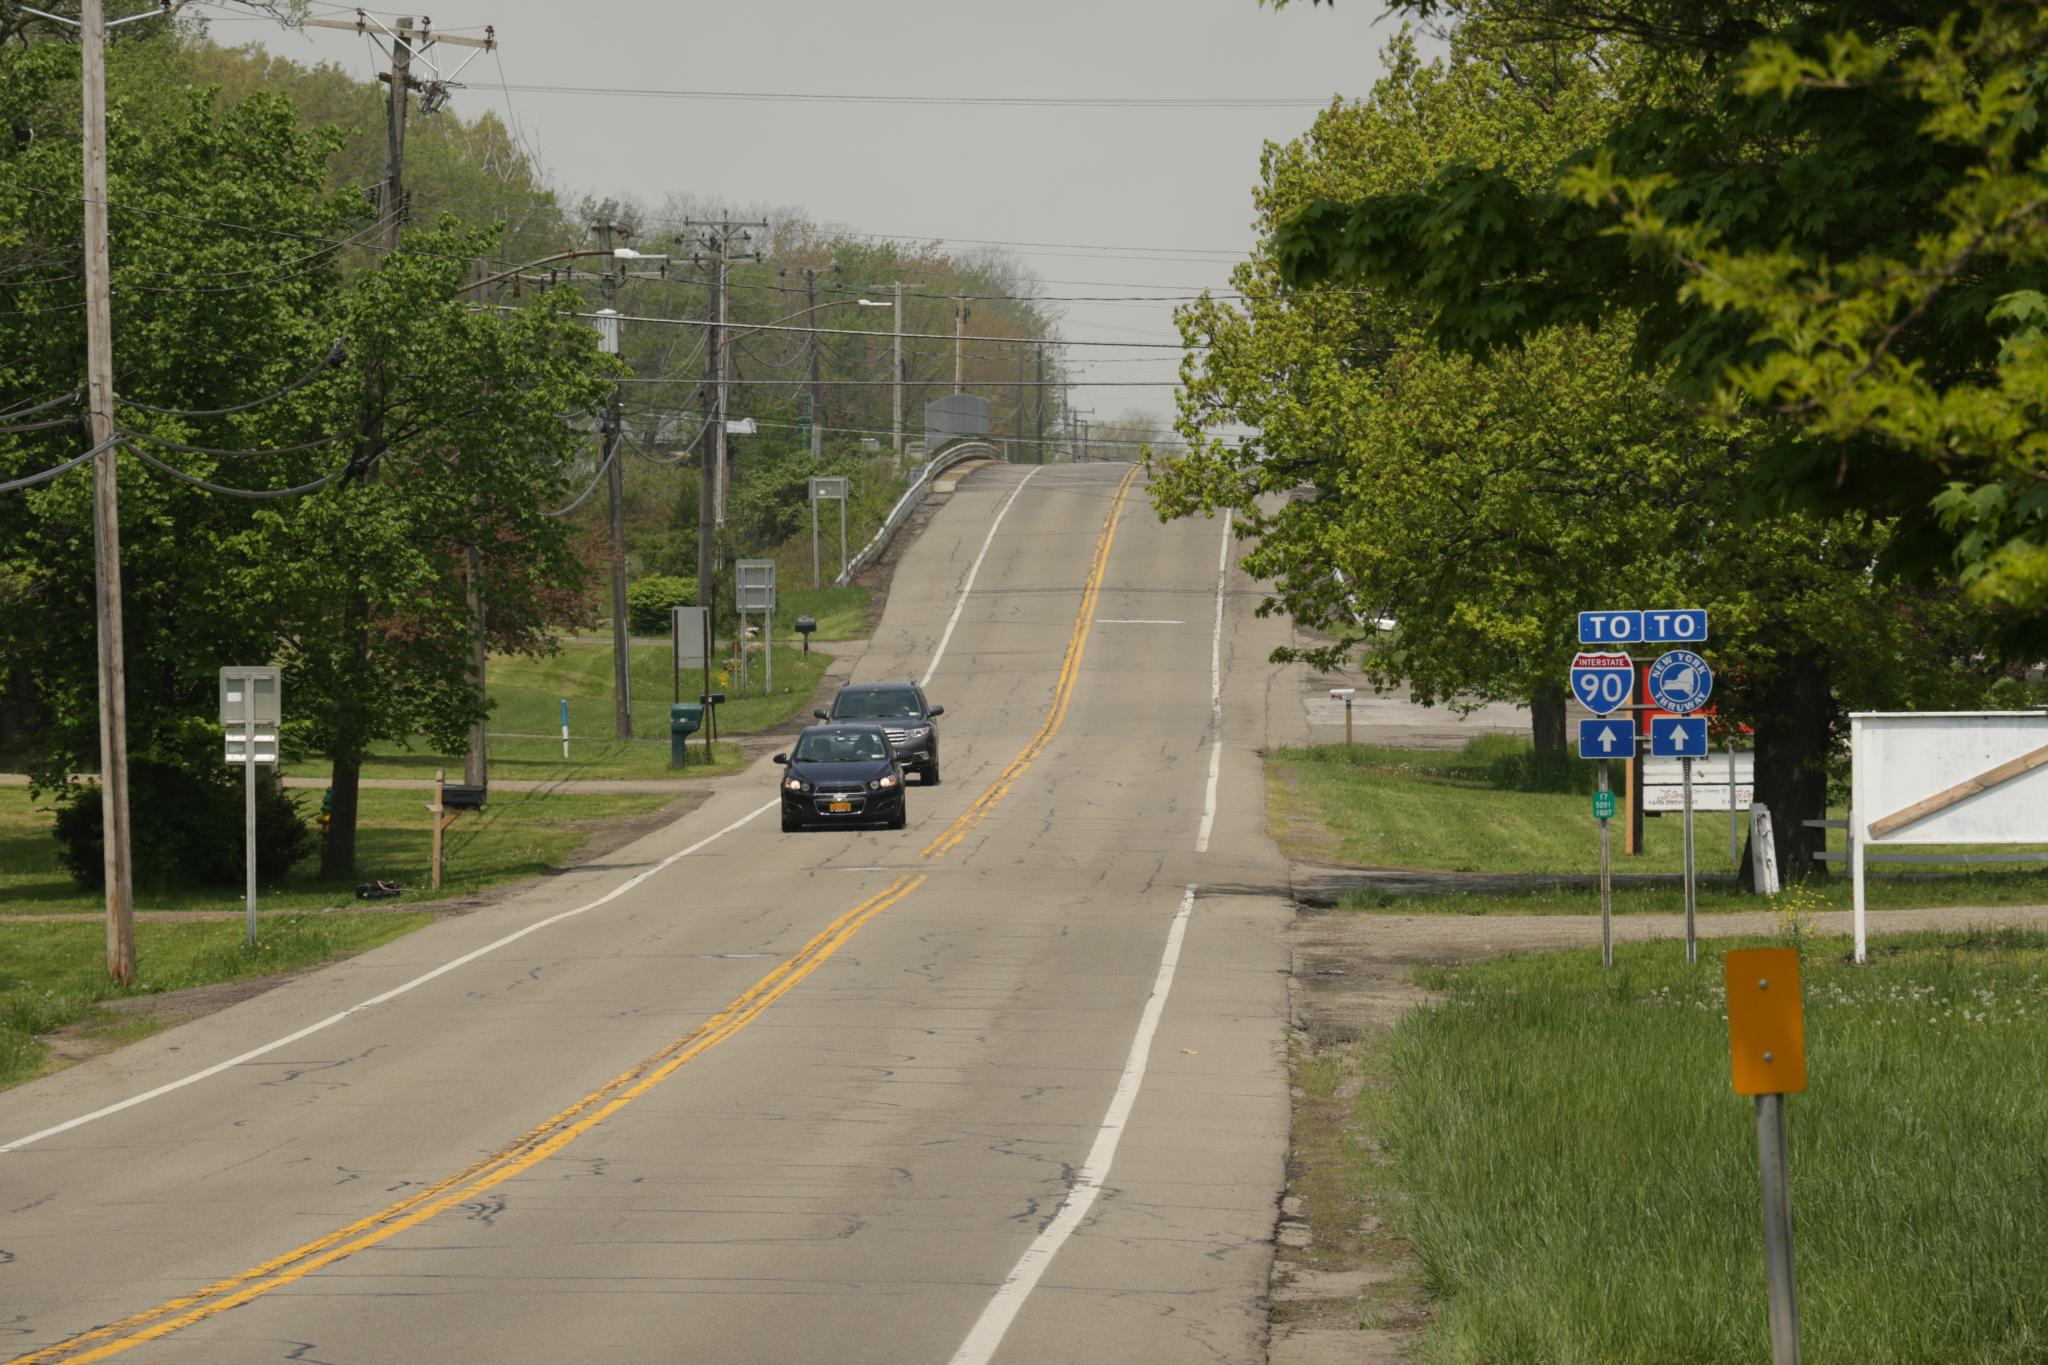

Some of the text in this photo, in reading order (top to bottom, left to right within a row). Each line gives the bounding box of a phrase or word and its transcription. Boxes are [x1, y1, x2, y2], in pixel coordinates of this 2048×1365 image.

[1590, 616, 1631, 638] TO
[1654, 614, 1695, 637] TO
[1579, 658, 1625, 667] INTERSTATE
[1652, 653, 1707, 678] NEW YORK
[1580, 673, 1622, 702] 90
[1655, 691, 1706, 712] THRUWAY
